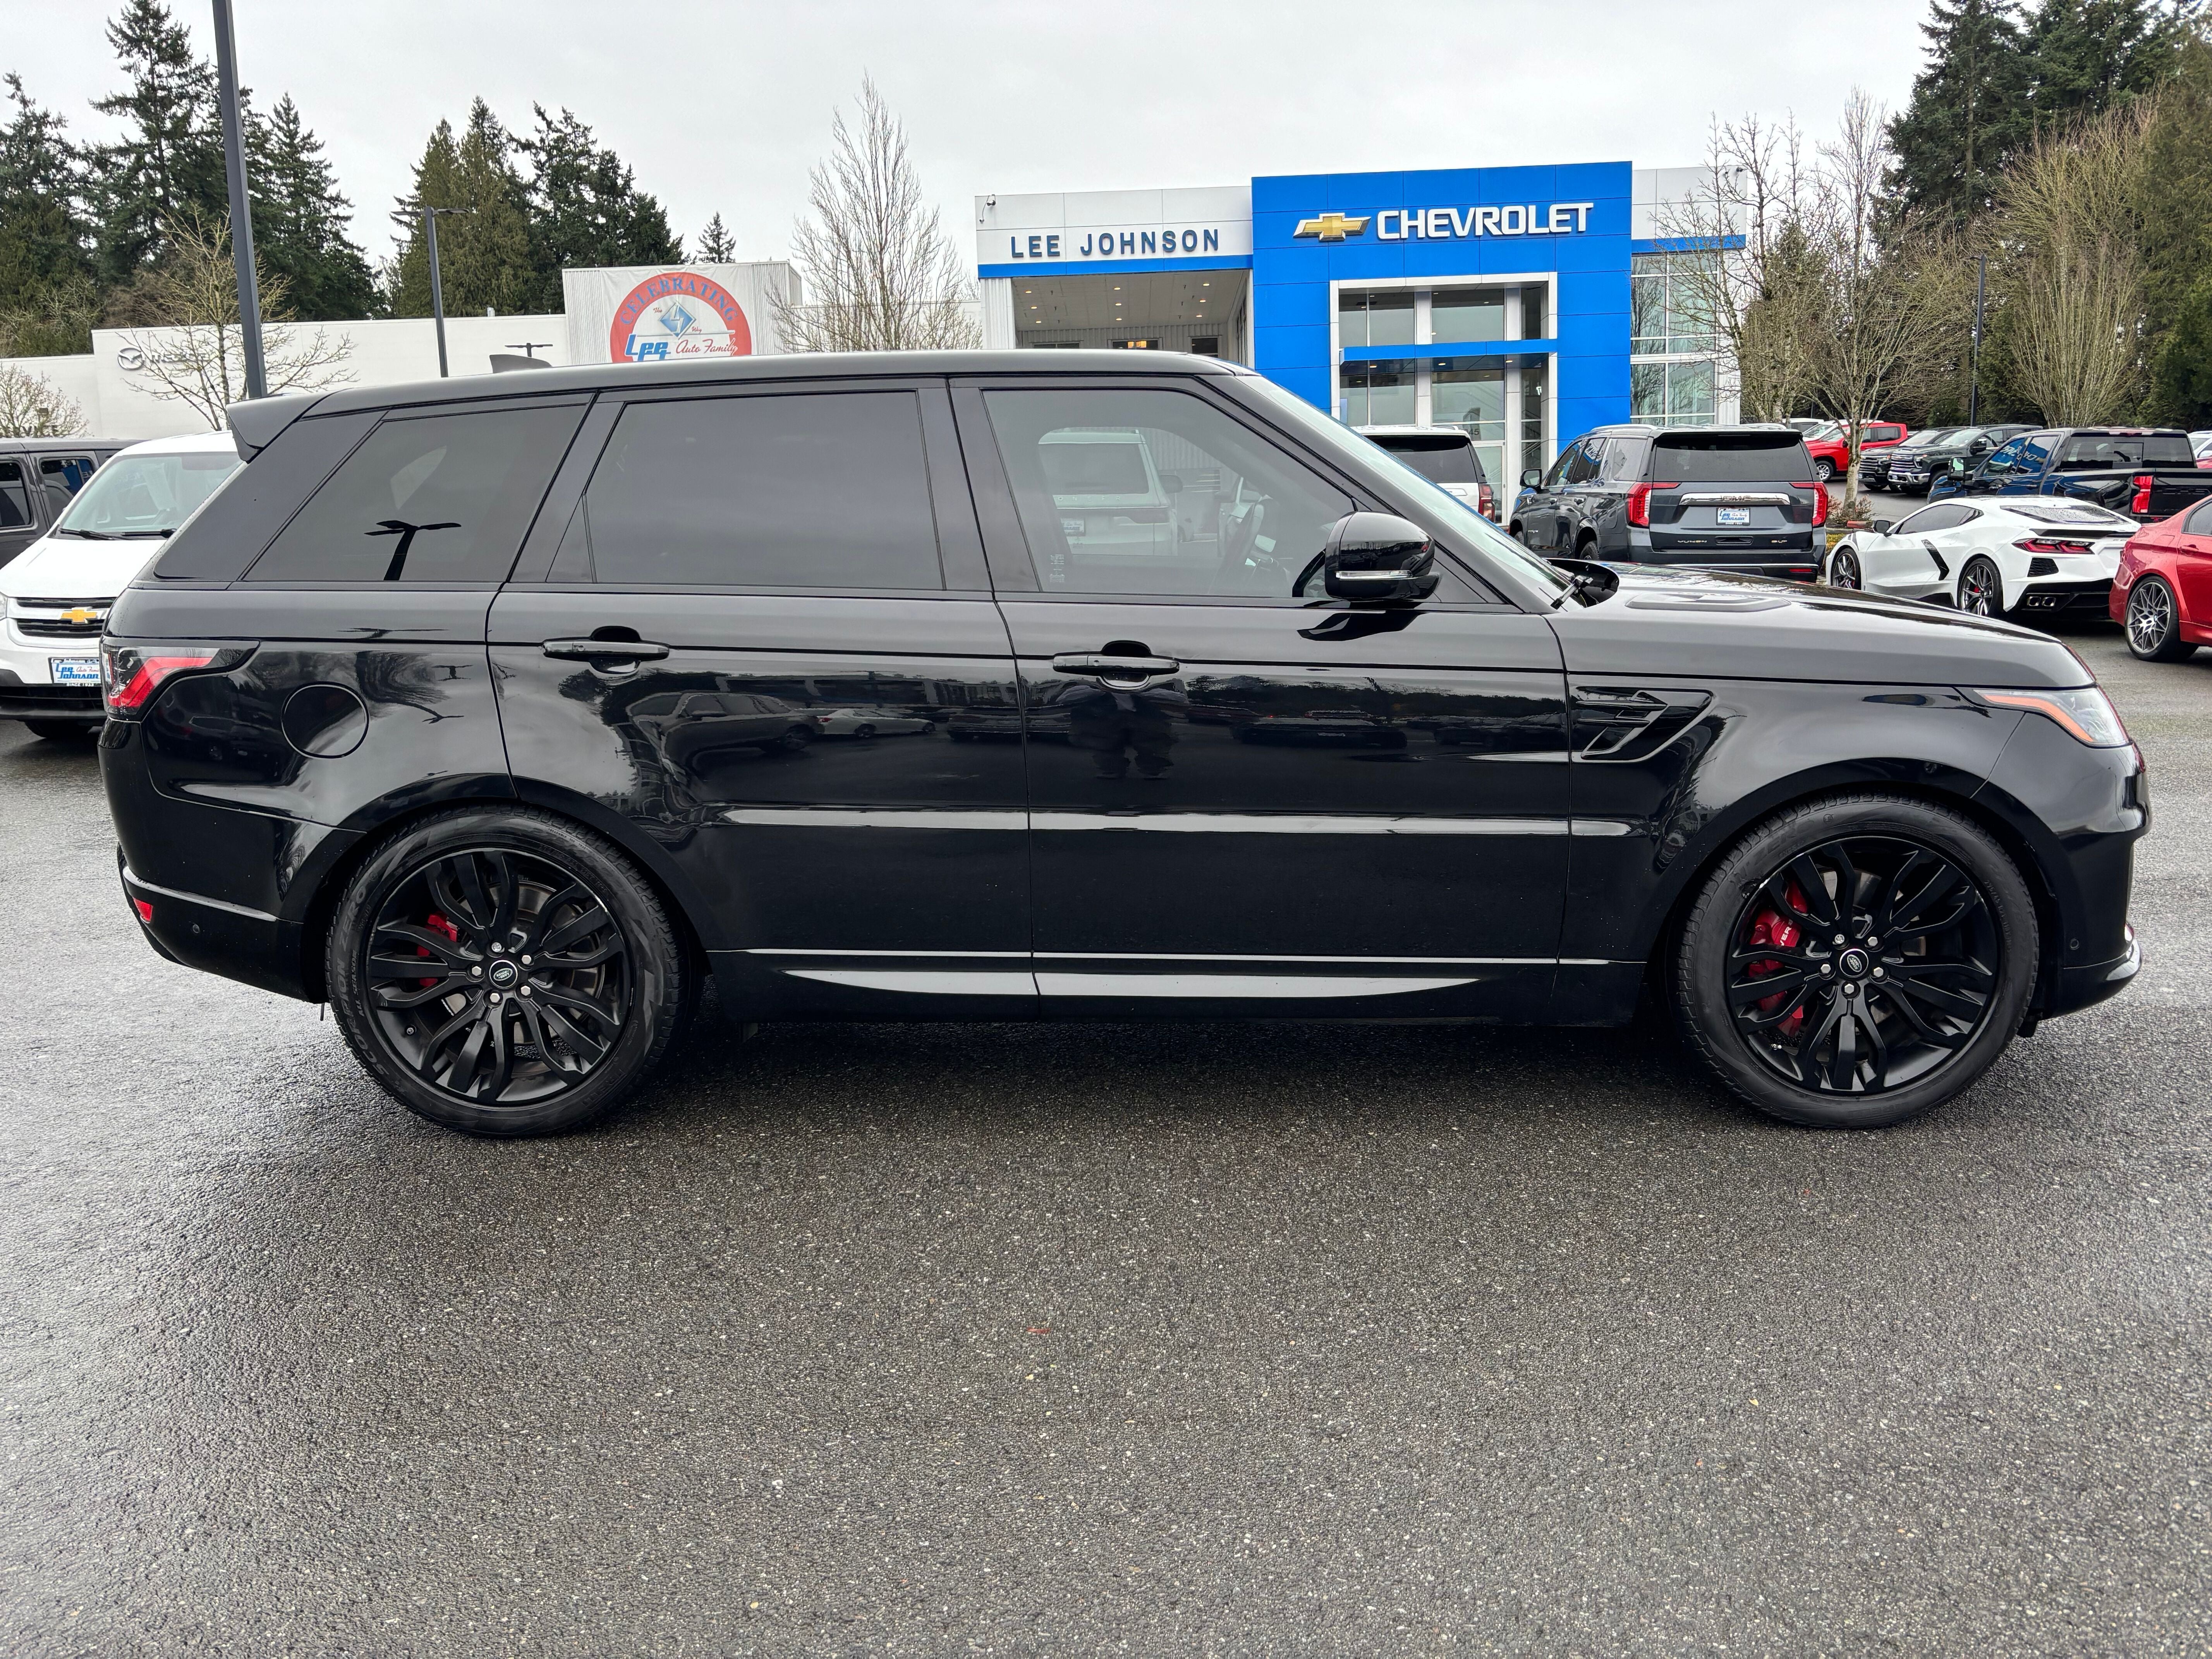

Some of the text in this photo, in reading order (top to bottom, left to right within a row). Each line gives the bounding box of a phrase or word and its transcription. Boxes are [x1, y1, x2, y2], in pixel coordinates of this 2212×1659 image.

[1378, 202, 1594, 239] CHEVROLET
[1011, 229, 1218, 258] LEE JOHNSON
[621, 277, 737, 324] CELEBRATING
[625, 334, 738, 356] Lee Auto Family
[56, 663, 74, 672] Lee
[336, 885, 390, 1080] SCORPION ZERO
[350, 949, 365, 1017] ALL SEASON
